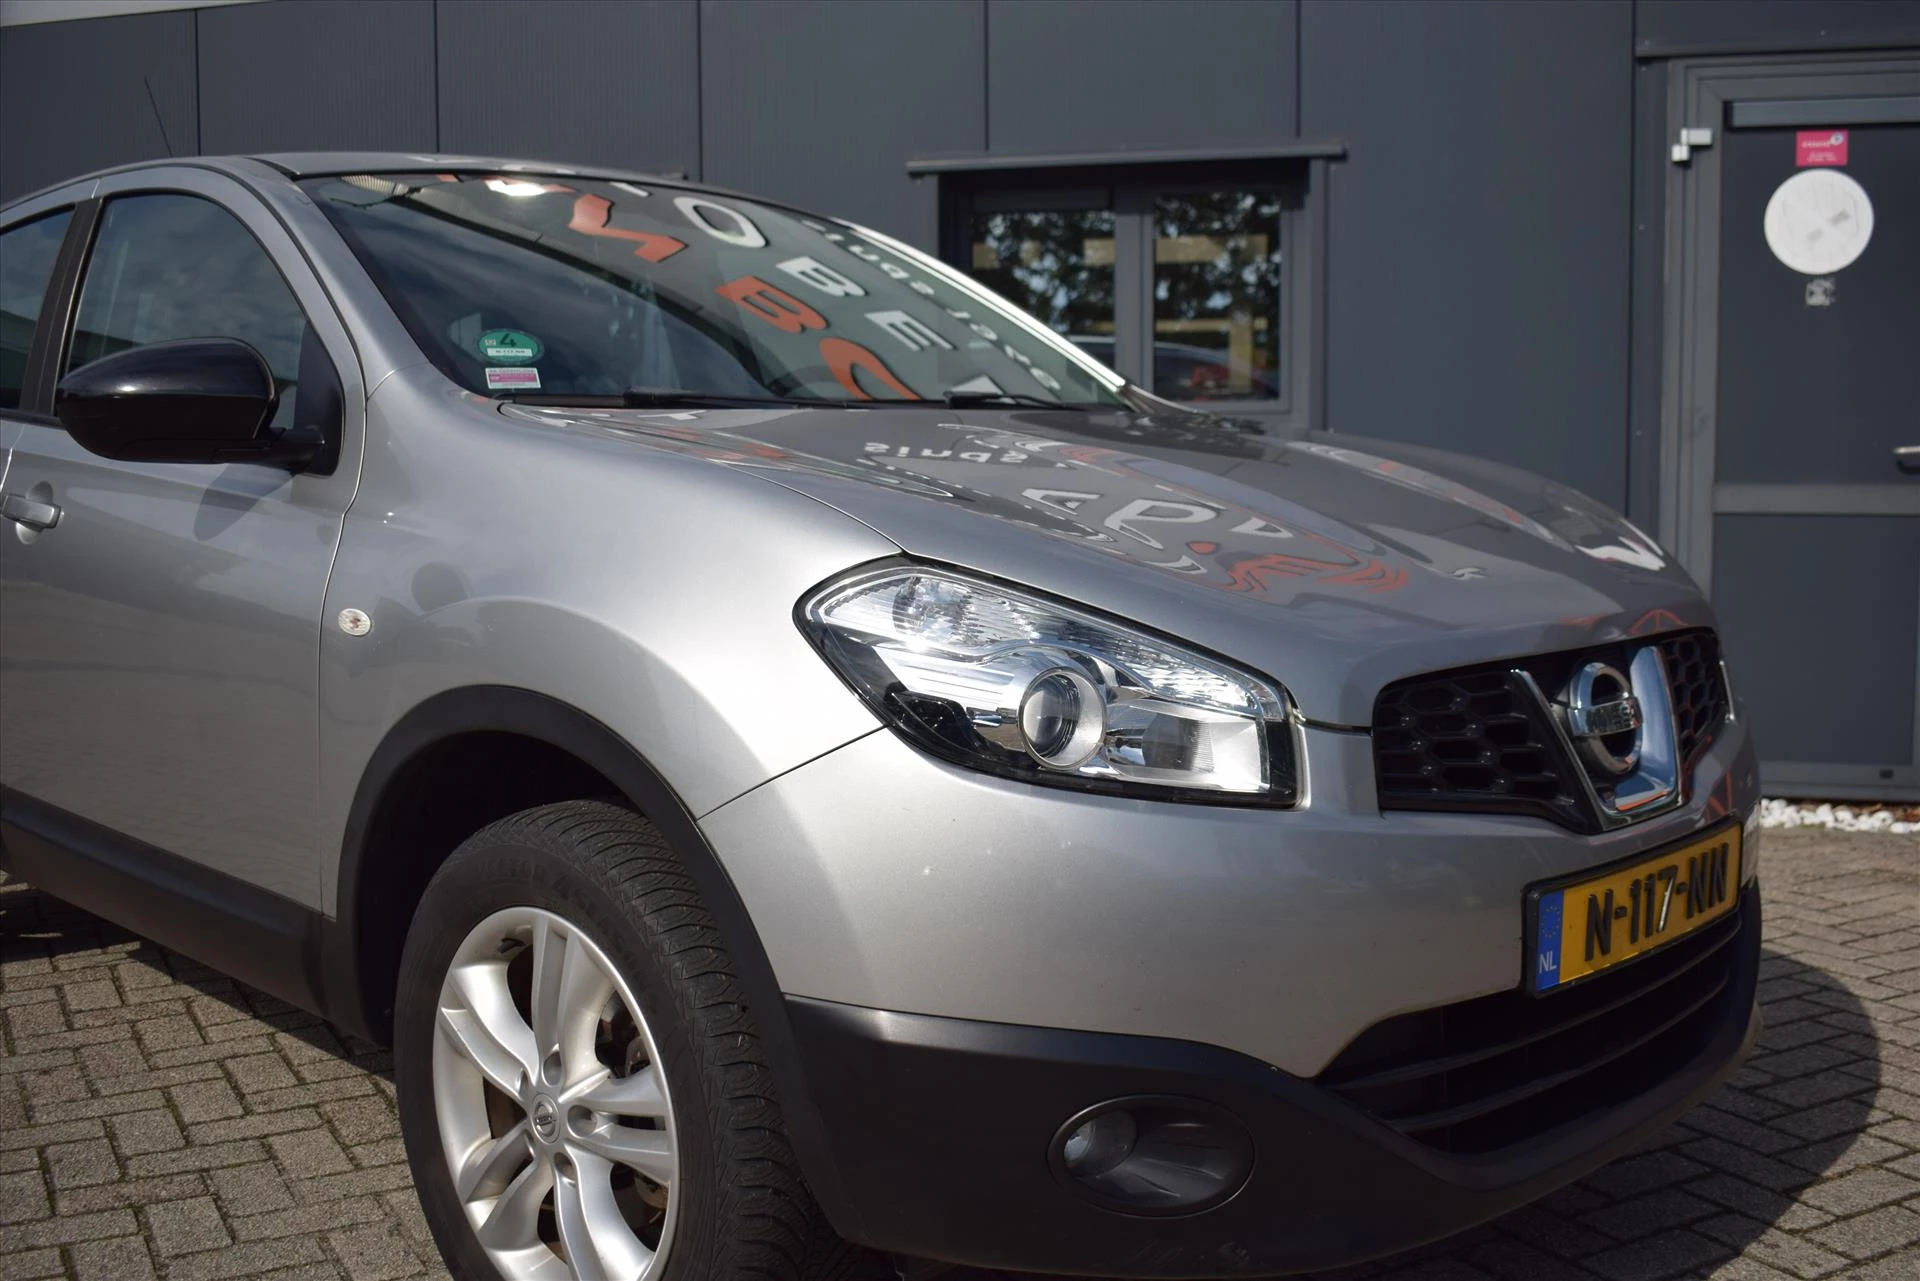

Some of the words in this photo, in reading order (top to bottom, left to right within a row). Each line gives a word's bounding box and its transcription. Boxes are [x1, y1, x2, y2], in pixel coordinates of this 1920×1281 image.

[499, 332, 517, 348] 4
[1584, 842, 1730, 962] N-117-NN
[1538, 950, 1557, 974] NL
